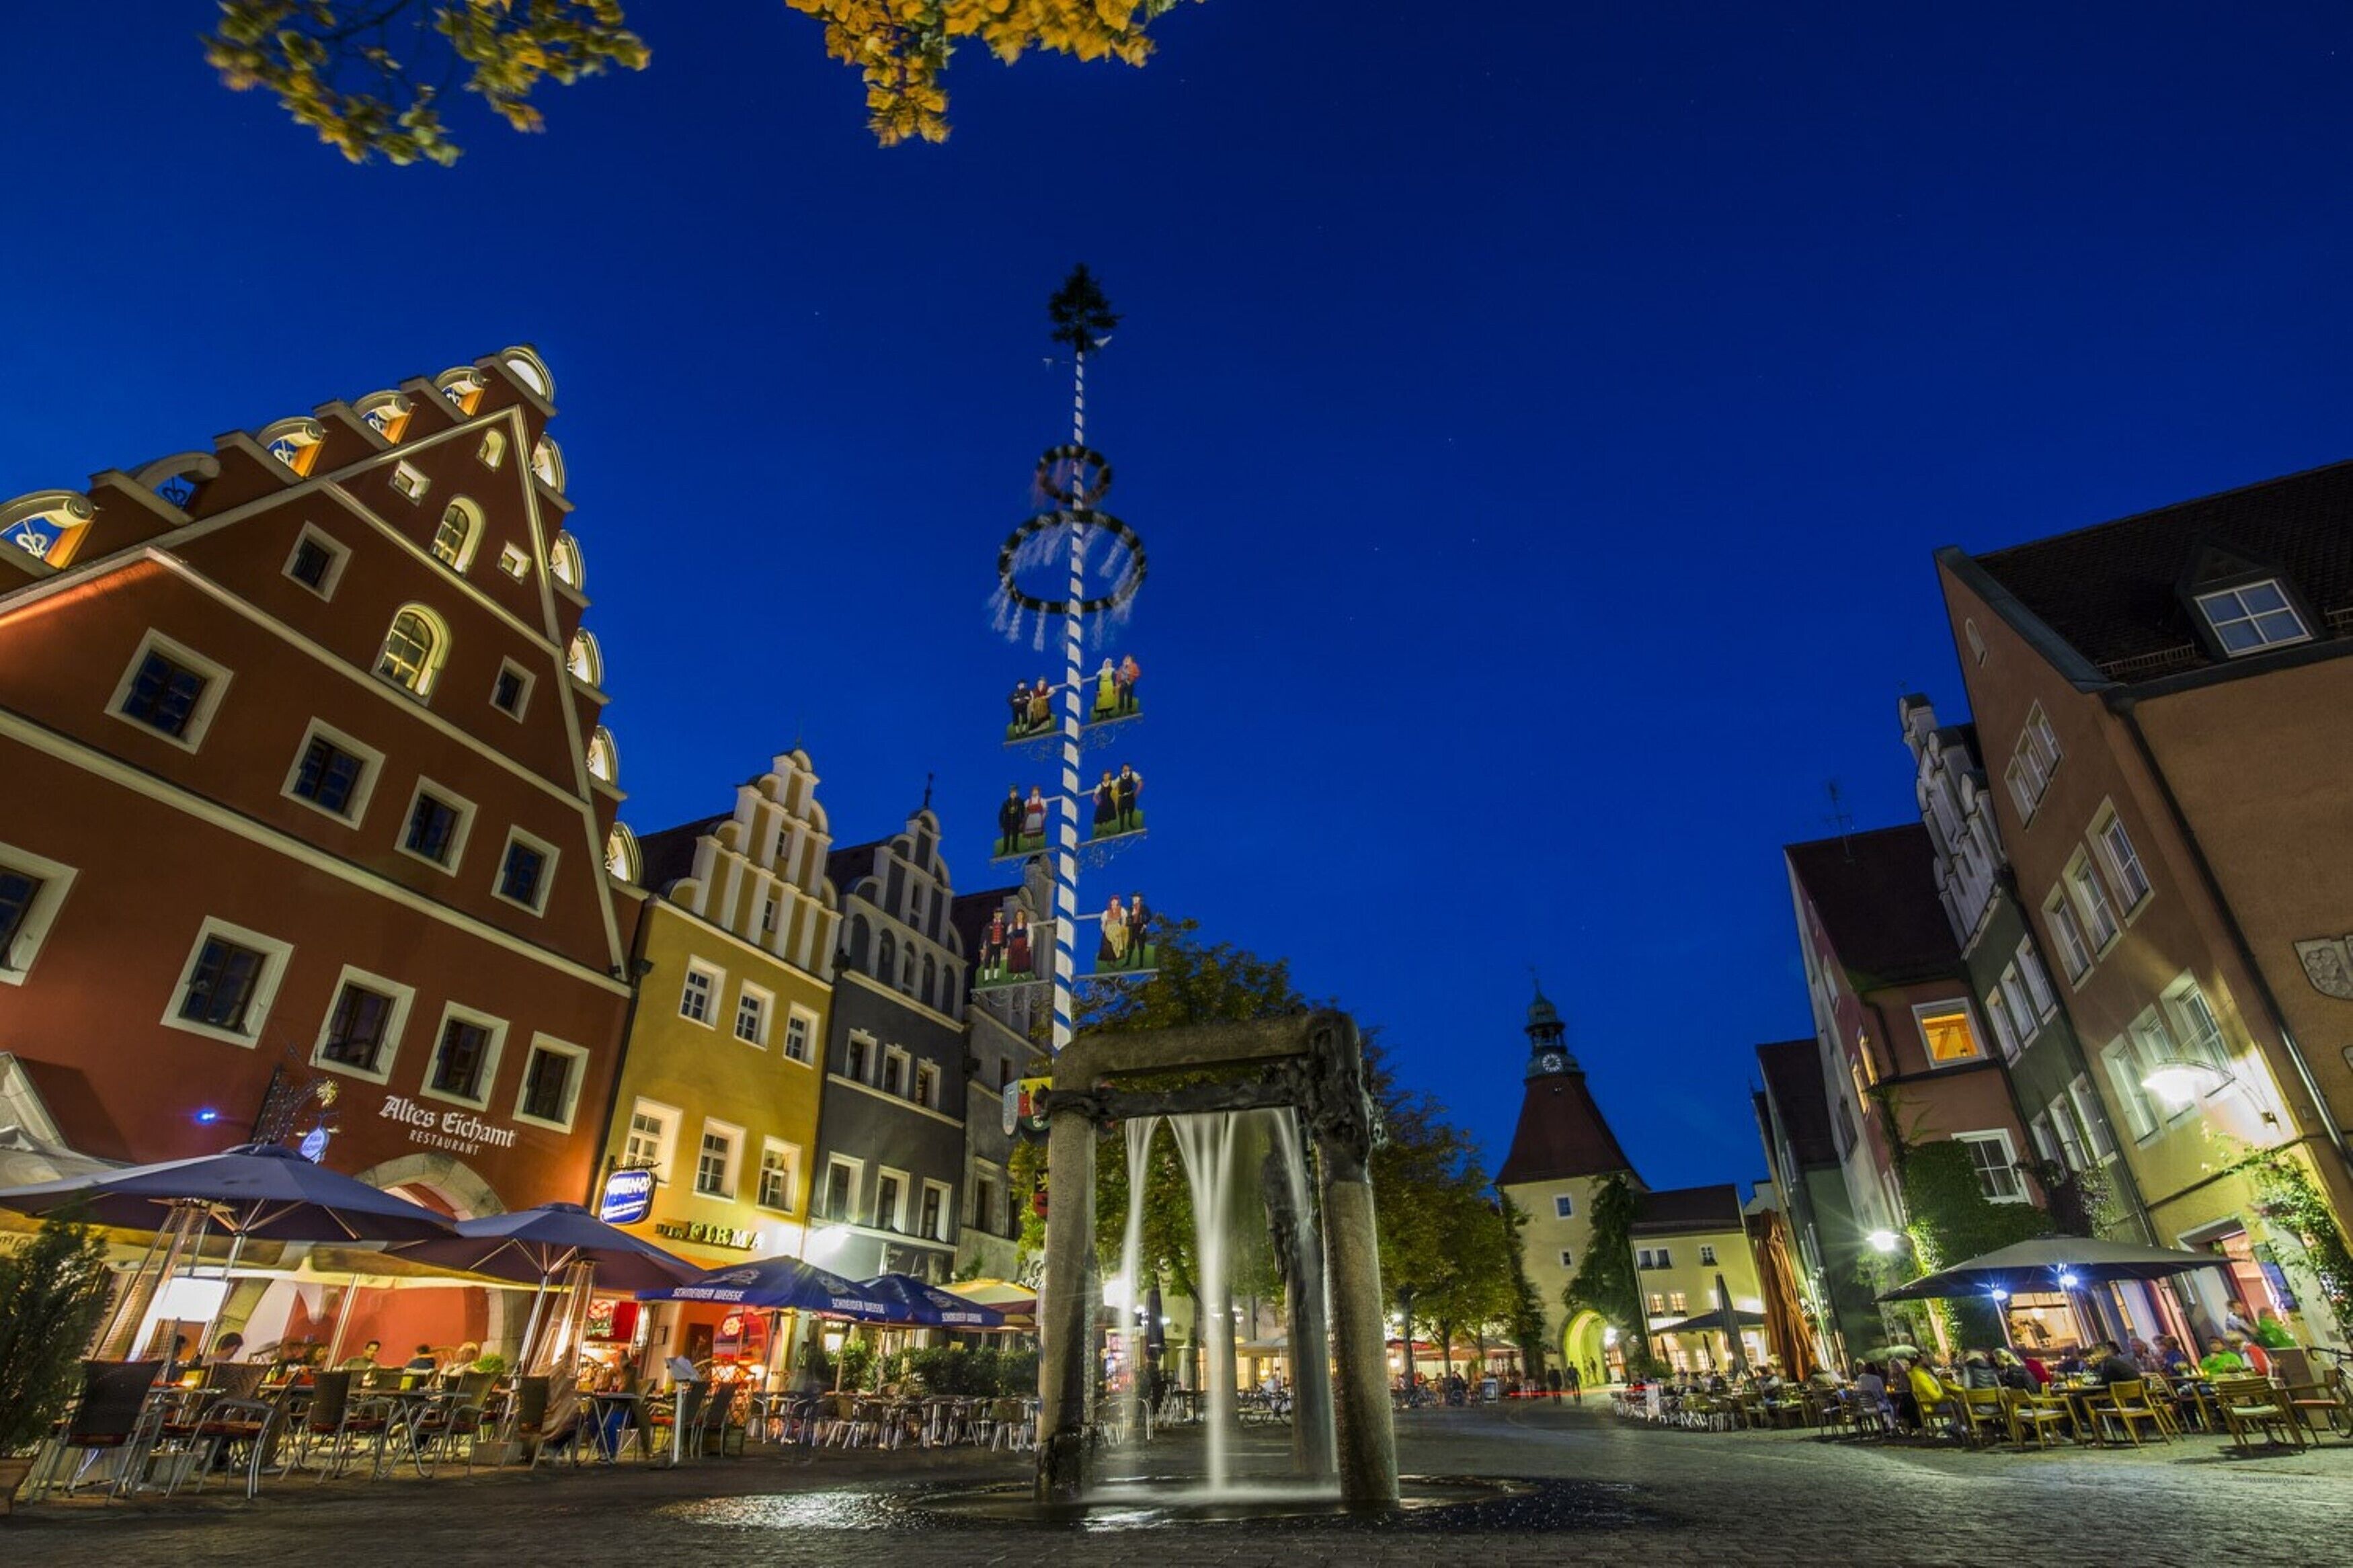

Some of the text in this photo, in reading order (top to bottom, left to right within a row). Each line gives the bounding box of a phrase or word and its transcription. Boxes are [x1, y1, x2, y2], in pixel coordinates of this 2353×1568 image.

[379, 1095, 516, 1148] Altes Eichamt
[409, 1130, 481, 1156] RESTAURANT
[688, 1223, 766, 1250] FIRMA
[672, 1287, 716, 1299] SCHNEIDER
